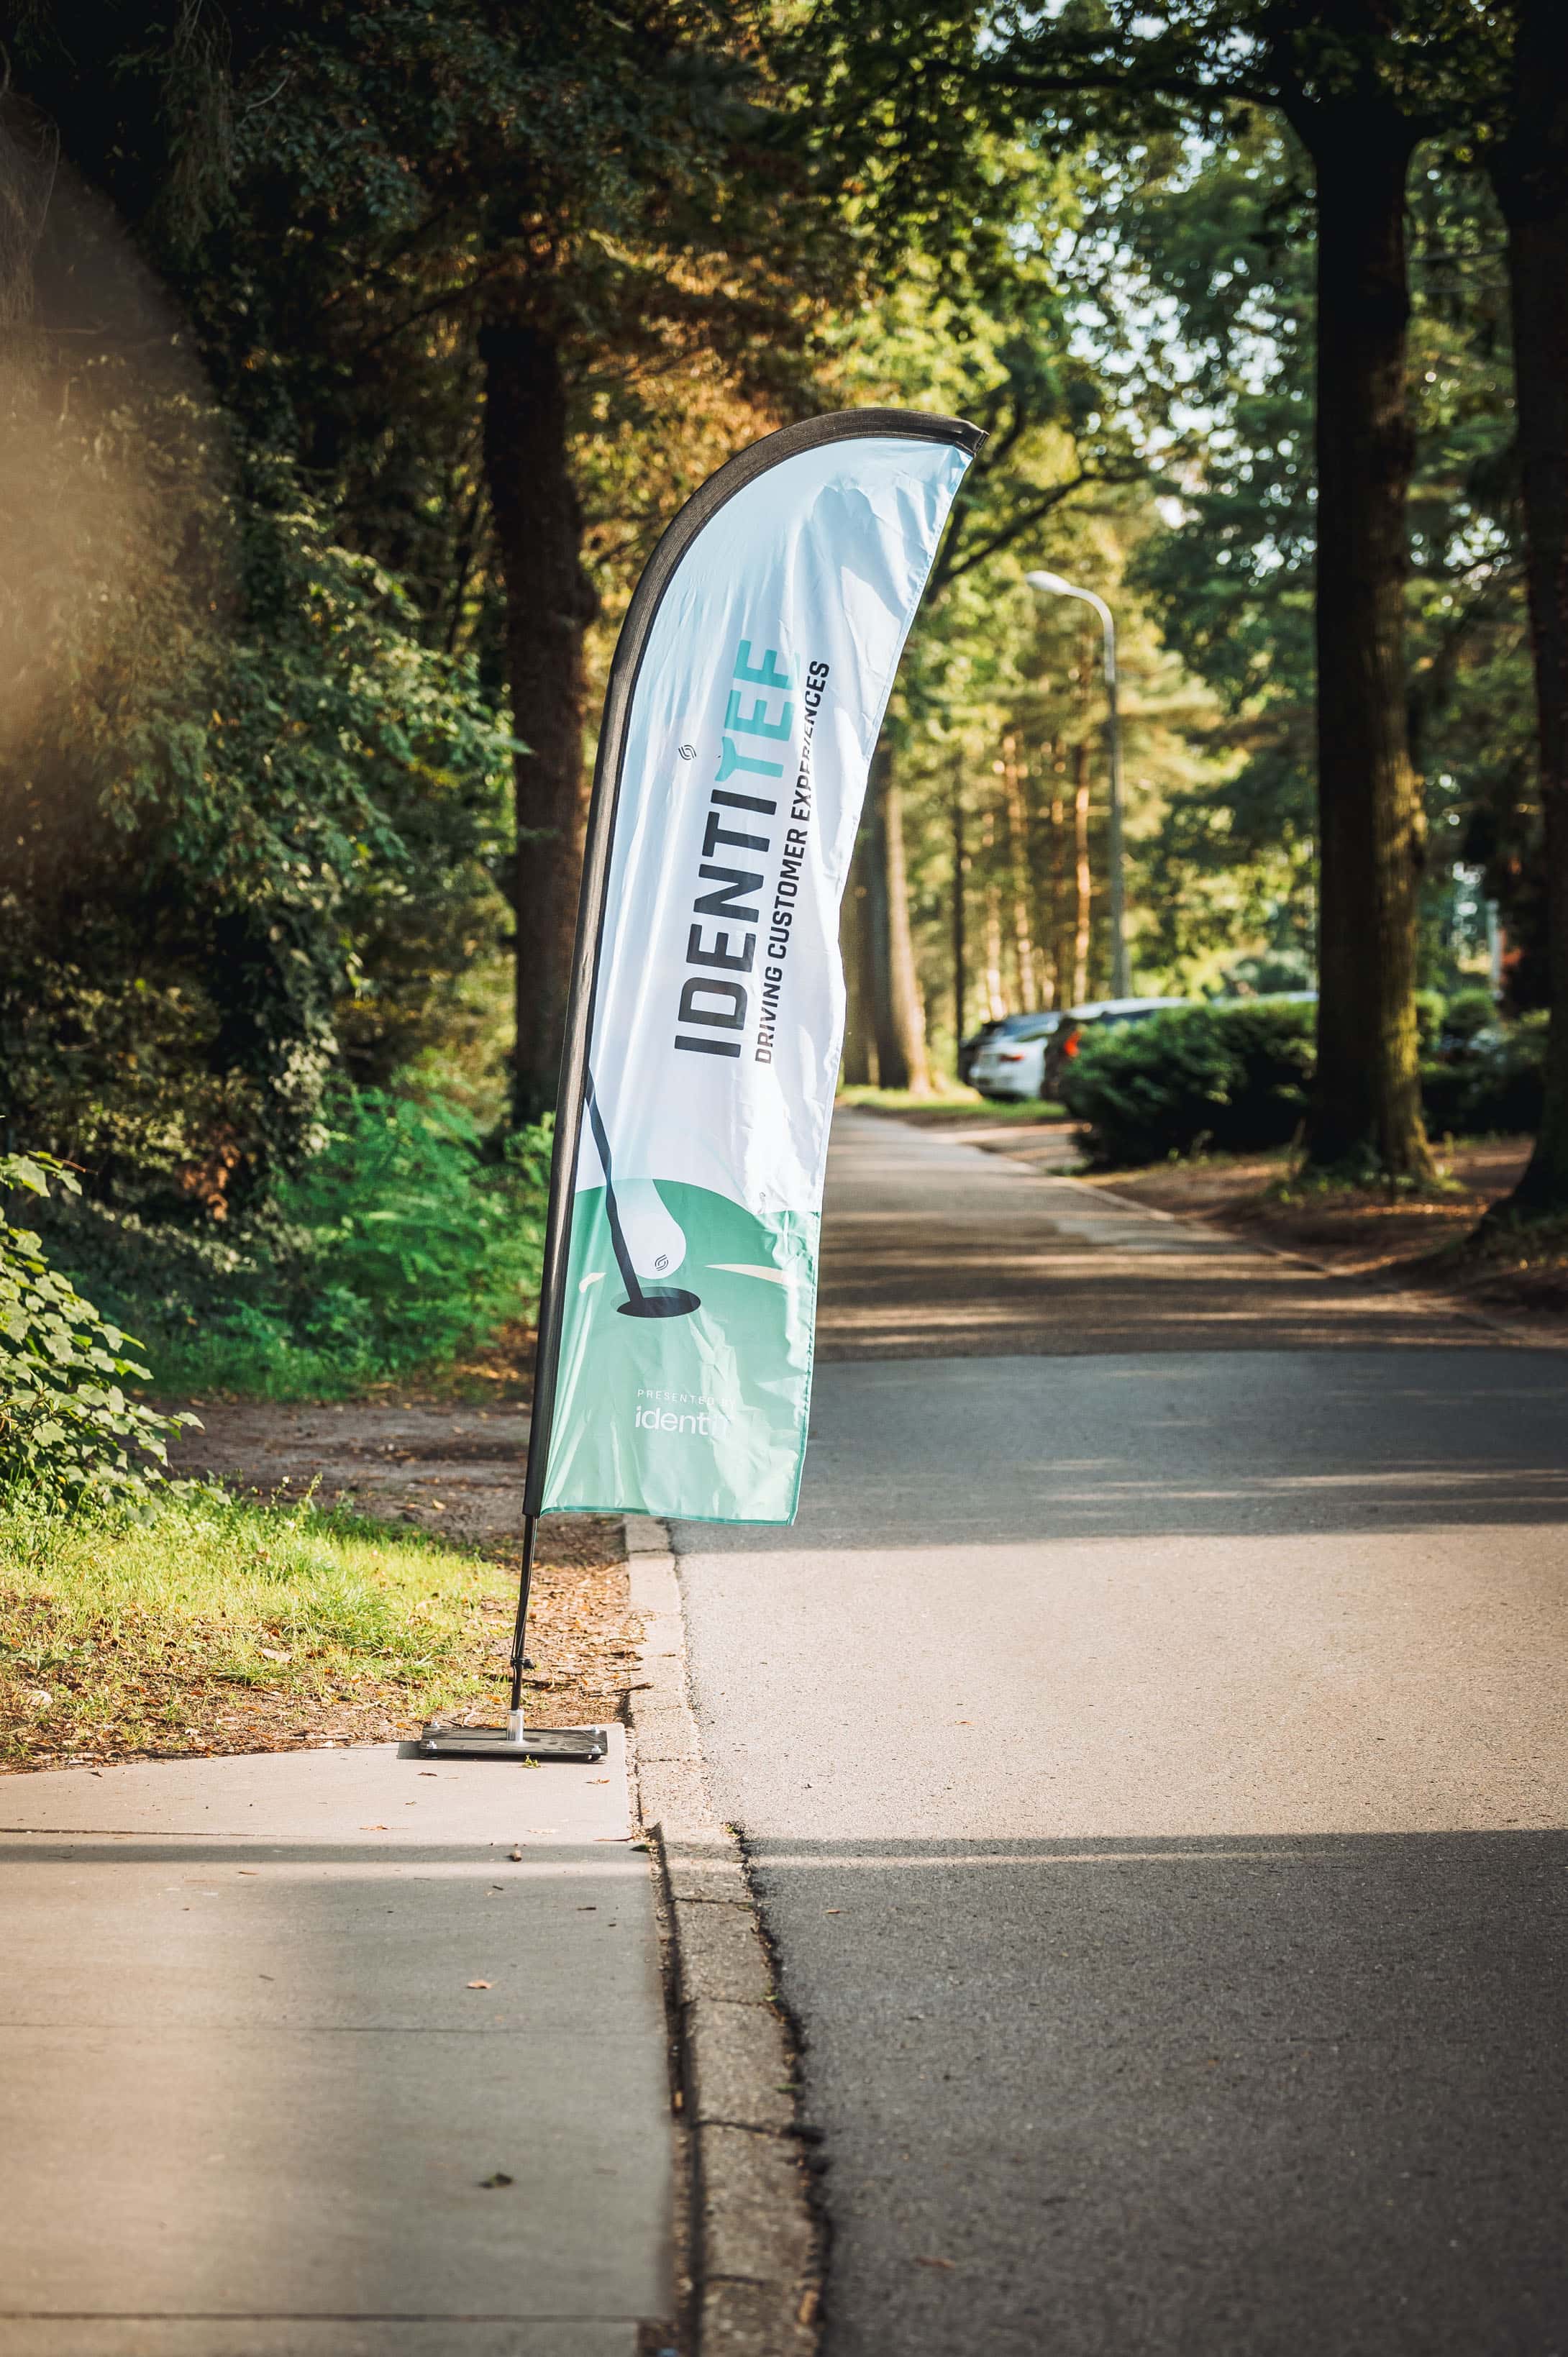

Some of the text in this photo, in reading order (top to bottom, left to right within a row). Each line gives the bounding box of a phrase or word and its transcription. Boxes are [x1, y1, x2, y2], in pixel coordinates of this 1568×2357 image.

[767, 828, 808, 960] CUSTOMER
[755, 965, 783, 1064] DRIVING
[637, 1389, 714, 1405] PRESENTED
